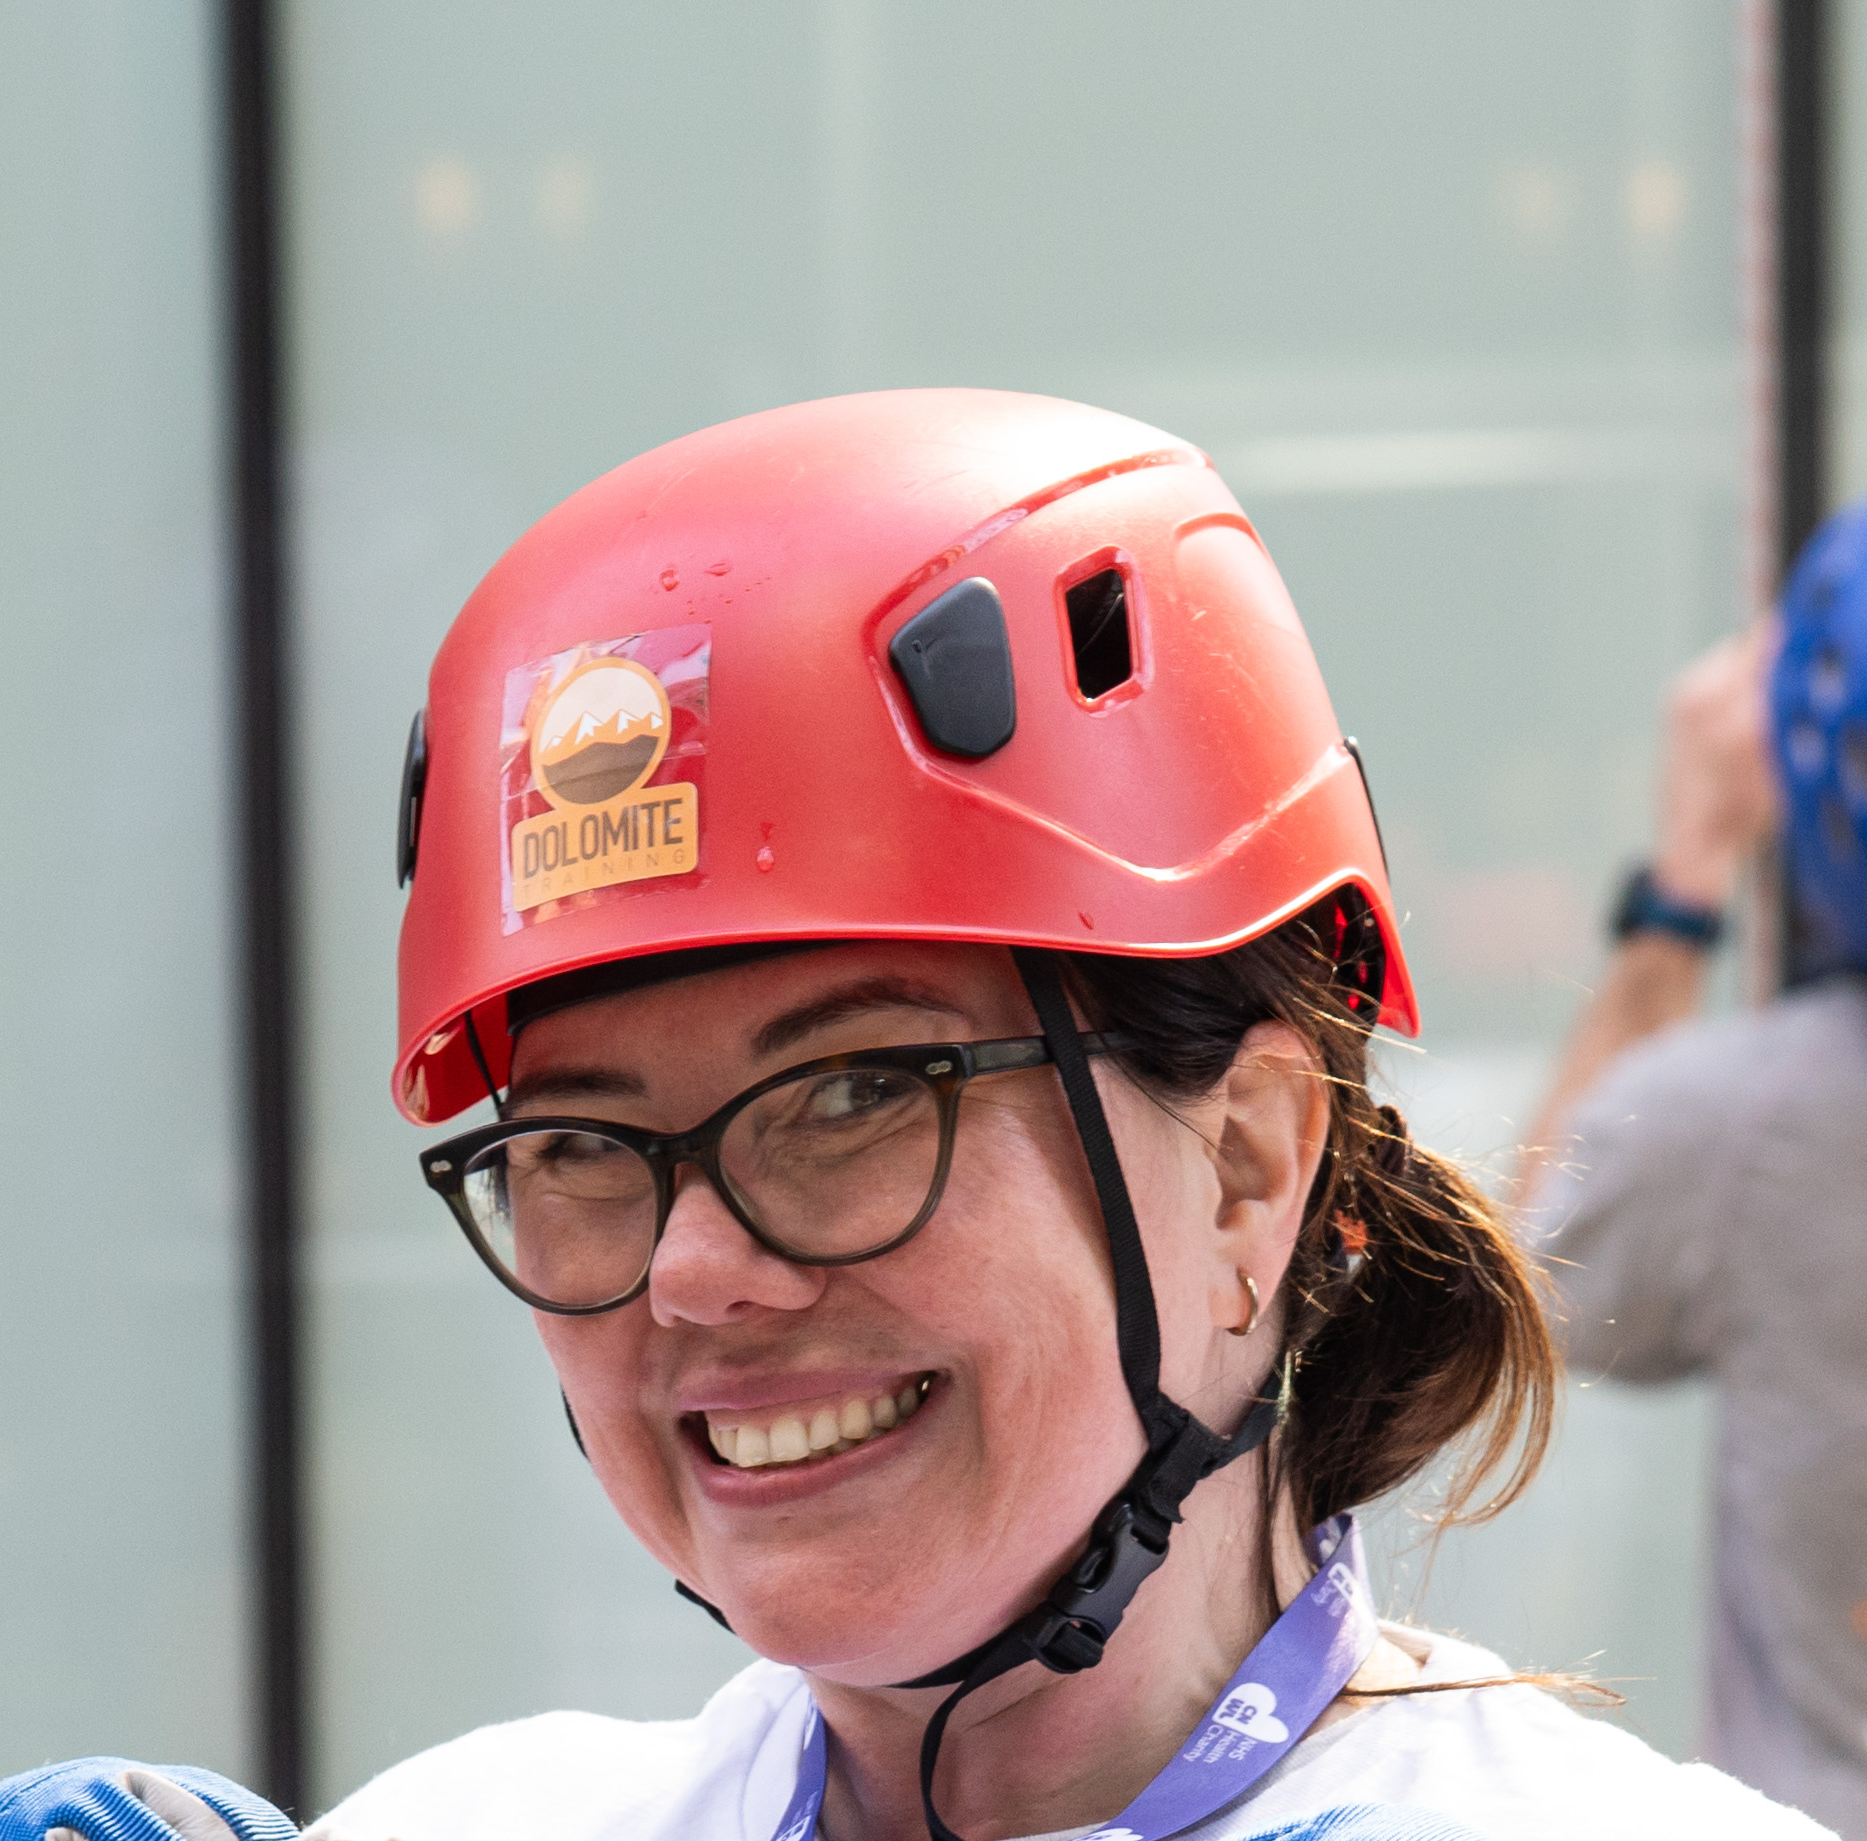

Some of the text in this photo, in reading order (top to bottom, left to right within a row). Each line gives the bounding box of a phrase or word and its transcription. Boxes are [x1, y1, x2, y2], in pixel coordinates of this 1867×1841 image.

[523, 797, 684, 879] DOLOMITE
[522, 848, 685, 898] TRAINING
[1236, 1705, 1257, 1725] CN
[1203, 1730, 1242, 1763] Health
[1228, 1736, 1258, 1760] NHS
